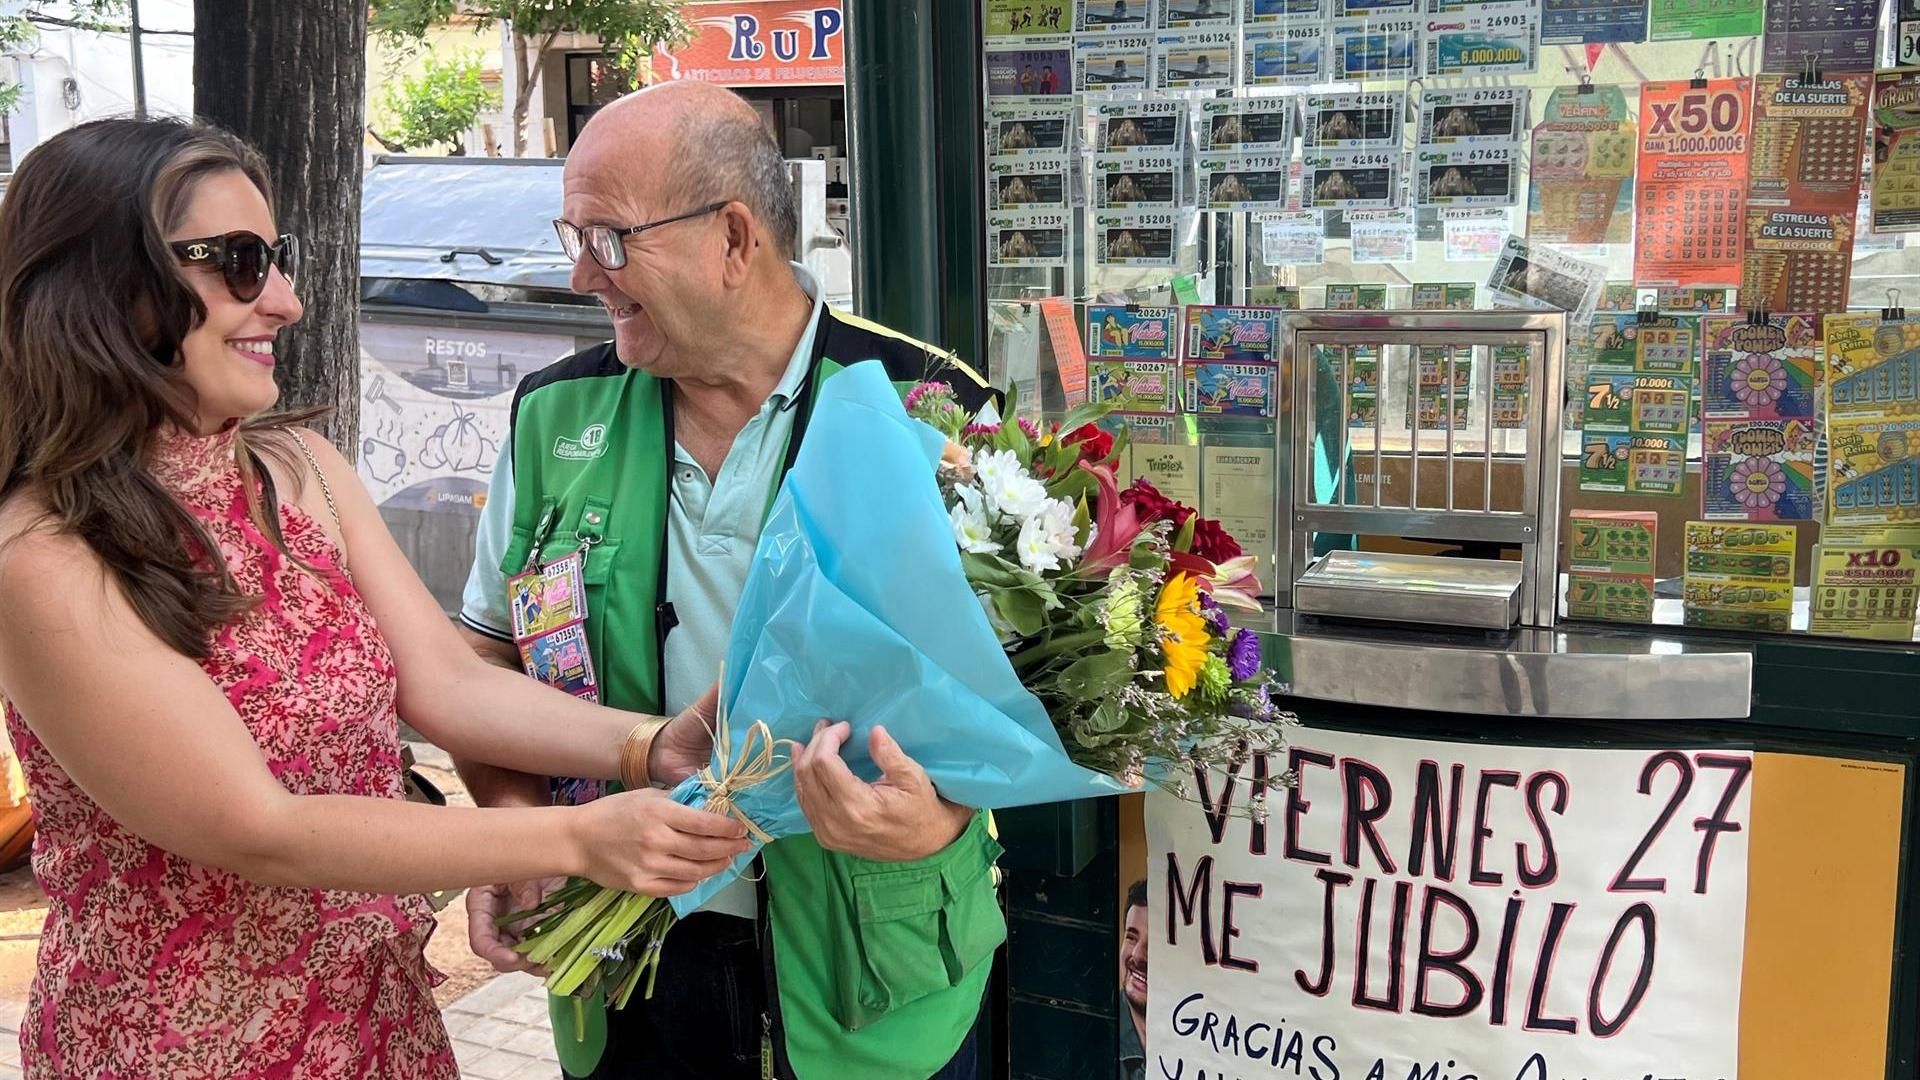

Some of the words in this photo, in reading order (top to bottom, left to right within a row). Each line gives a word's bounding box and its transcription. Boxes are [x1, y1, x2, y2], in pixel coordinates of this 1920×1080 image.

[1380, 21, 1413, 31] 48123
[1487, 15, 1526, 27] 26903
[1199, 33, 1231, 43] 86124
[1288, 28, 1320, 39] 90635
[1118, 38, 1147, 48] 15276
[754, 68, 771, 80] DE
[1356, 95, 1393, 105] 42846
[1474, 90, 1513, 100] 67623
[1775, 93, 1791, 103] DE
[1792, 93, 1806, 103] LA
[1807, 93, 1847, 104] SUERTE
[1143, 103, 1177, 112] 85208
[1249, 100, 1284, 110] 91787
[1649, 93, 1739, 134] x50
[1645, 142, 1665, 151] GANA
[1668, 136, 1743, 153] 1.000.000€
[1352, 155, 1389, 164] 42846
[1469, 150, 1509, 160] 67623
[1029, 161, 1061, 170] 21239
[1139, 159, 1172, 168] 85208
[1246, 158, 1280, 167] 91787
[1030, 215, 1062, 224] 21239
[1139, 215, 1172, 224] 85208
[1772, 212, 1828, 225] ESTRELLAS
[1763, 226, 1778, 236] DE
[1779, 227, 1793, 237] LA
[1794, 228, 1833, 239] SUERTE
[1138, 310, 1167, 318] 20267
[1240, 311, 1271, 319] 31830
[1592, 323, 1616, 350] 7
[1610, 335, 1624, 350] 1/2
[1829, 330, 1860, 344] Abeja
[425, 338, 487, 358] RESTOS
[1136, 363, 1166, 372] 20267
[1236, 367, 1266, 375] 31830
[1588, 384, 1611, 410] 7
[1606, 395, 1620, 410] 1/2
[1136, 417, 1166, 425] 20267
[1833, 434, 1863, 448] Abeja
[1584, 443, 1609, 470] 7
[1602, 455, 1616, 469] 1/2
[438, 492, 473, 505] LIPASAM
[1581, 527, 1599, 547] 7
[1691, 535, 1720, 544] FLASH
[1846, 550, 1901, 568] x10
[1193, 738, 1570, 890] VIERNES
[1607, 750, 1753, 895] 27
[1165, 850, 1264, 974] ME
